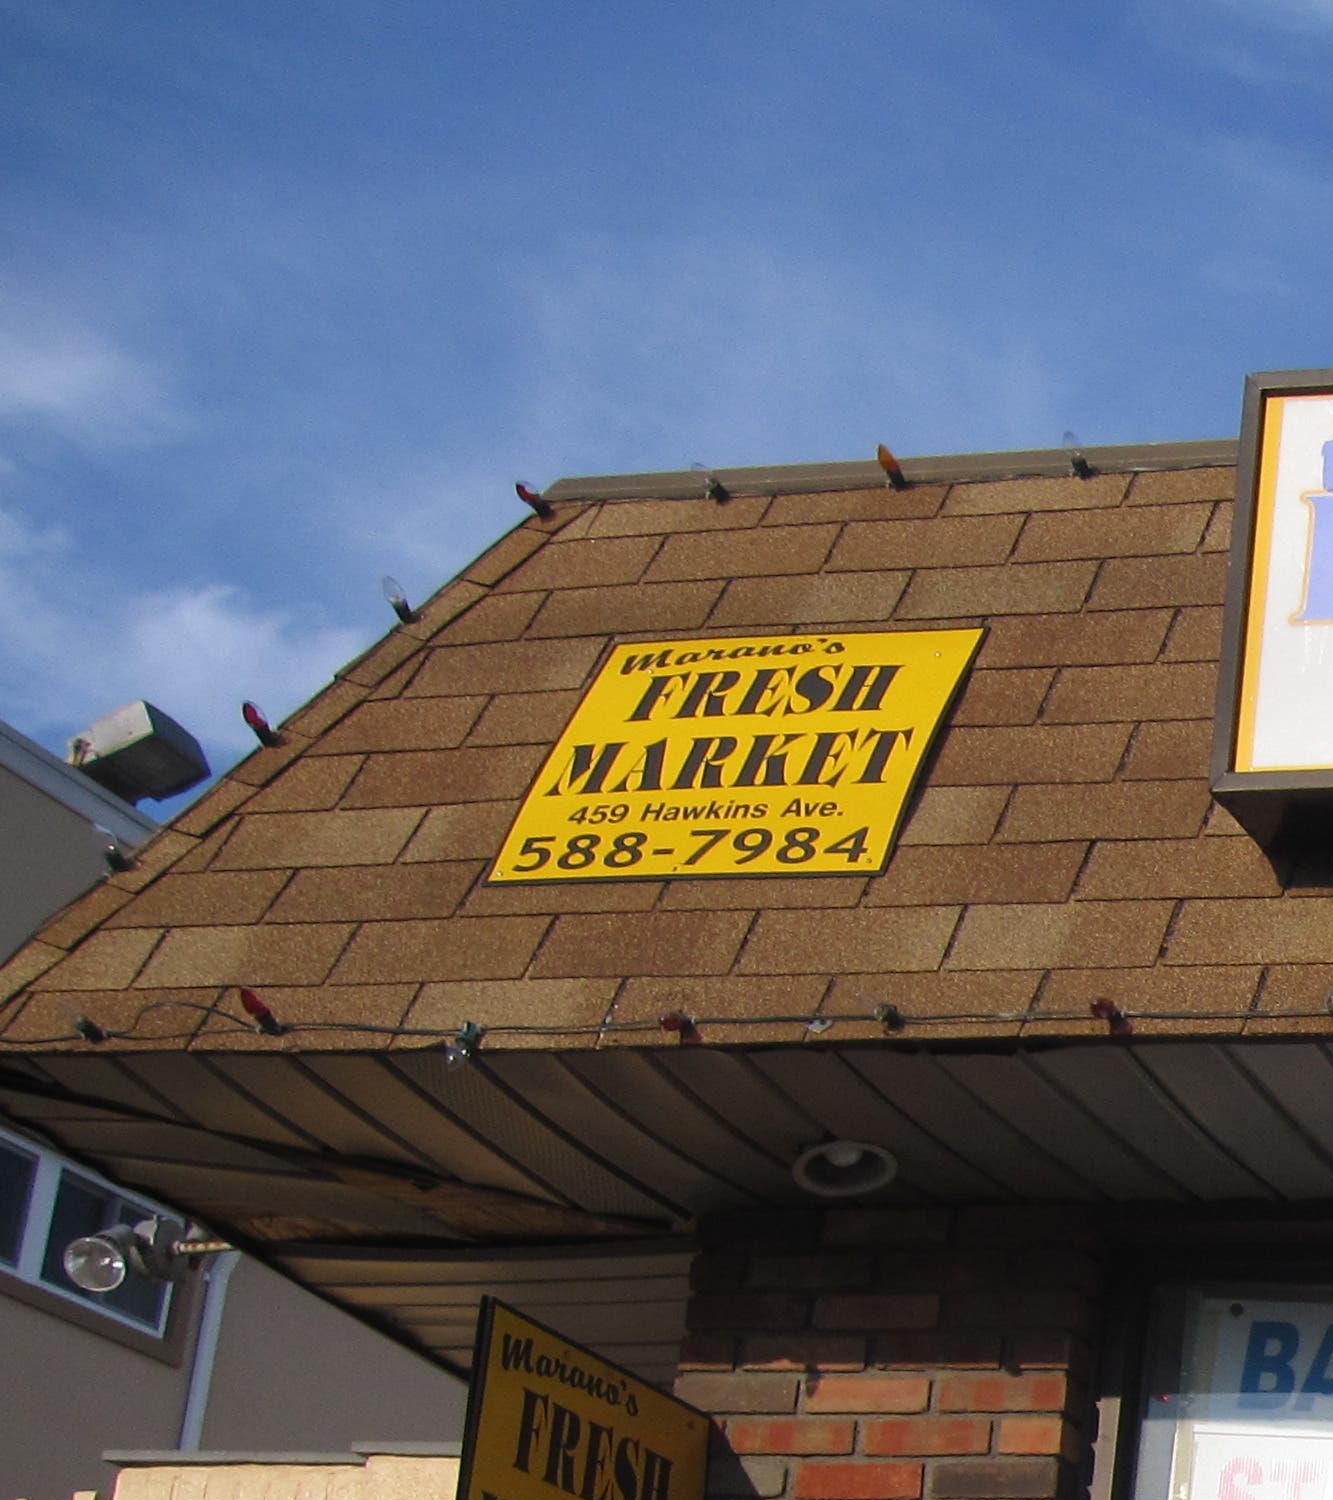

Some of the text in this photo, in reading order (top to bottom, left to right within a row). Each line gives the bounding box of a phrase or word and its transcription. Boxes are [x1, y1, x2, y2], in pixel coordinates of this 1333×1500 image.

[619, 637, 846, 676] Marano's
[624, 663, 904, 723] FRESH
[544, 727, 915, 797] MARKET
[568, 798, 845, 825] 459 Hawkins Ave.
[513, 826, 870, 873] 588-7984
[501, 1332, 640, 1417] Marano's
